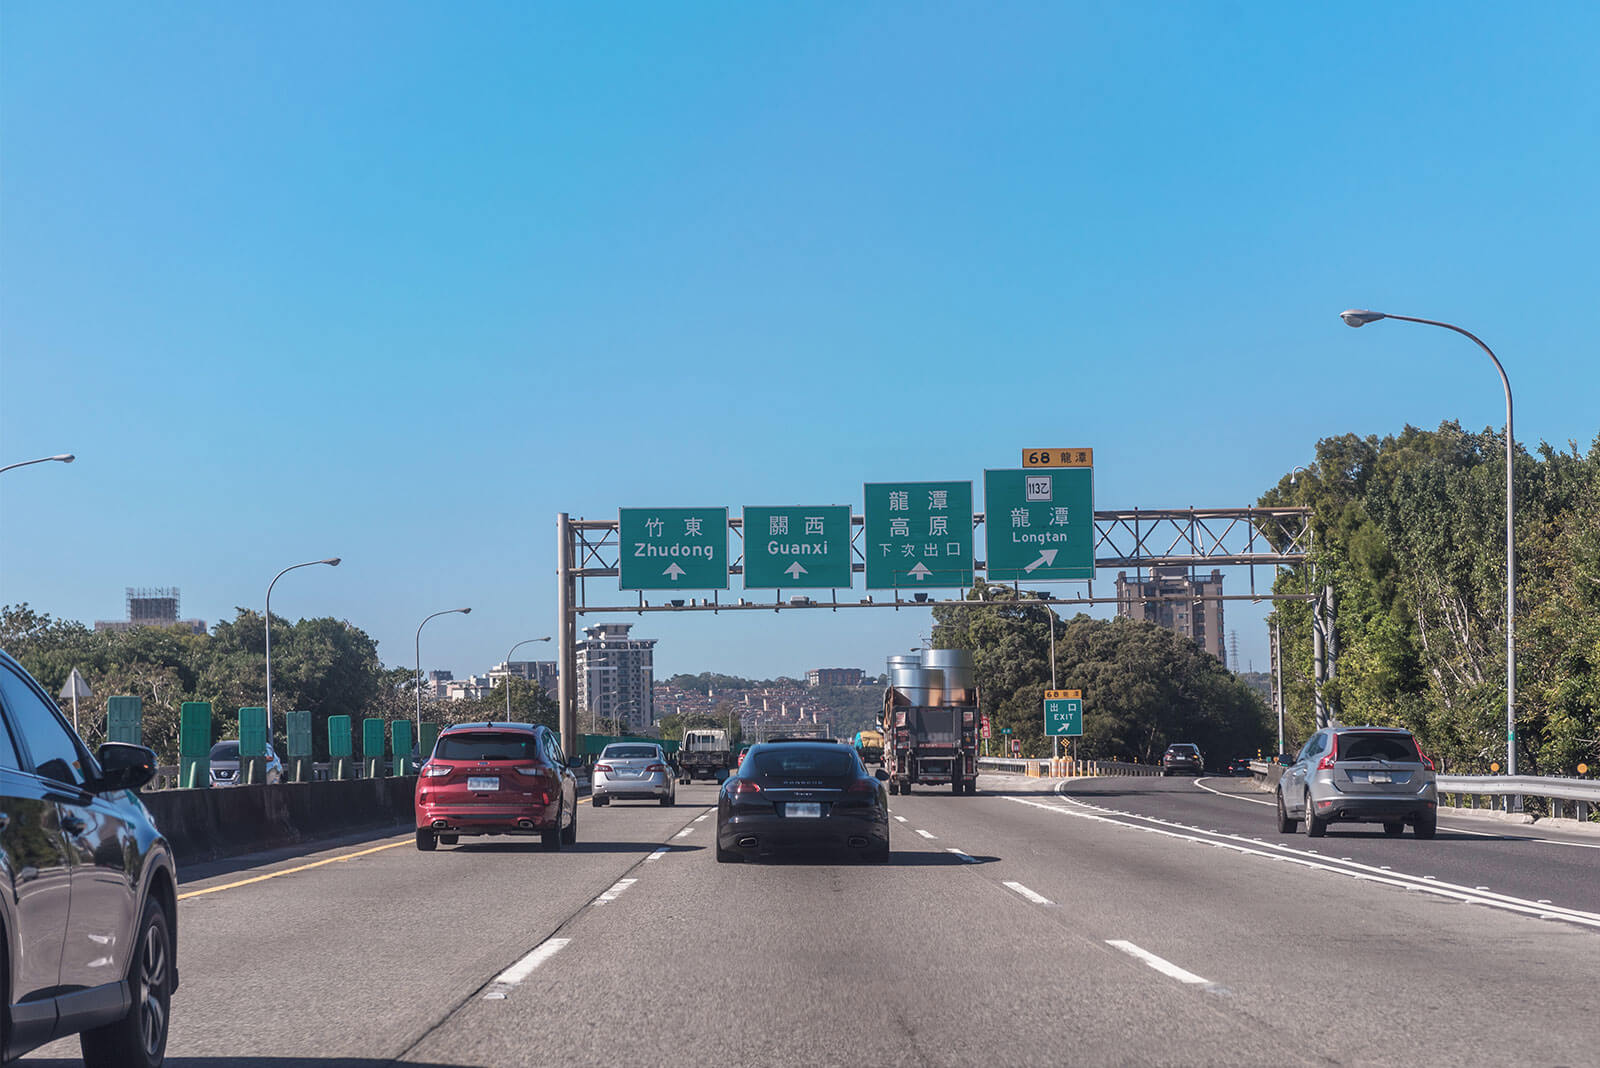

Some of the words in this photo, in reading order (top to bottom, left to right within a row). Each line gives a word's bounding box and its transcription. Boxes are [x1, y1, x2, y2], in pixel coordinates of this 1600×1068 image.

[1029, 452, 1050, 464] 68
[1028, 482, 1049, 495] 113乙
[888, 490, 948, 511] 龍潭
[769, 515, 825, 536] 關西
[1010, 507, 1069, 528] 龍潭
[644, 517, 703, 537] 竹東
[889, 516, 948, 537] 高原
[1012, 531, 1068, 545] Longtan
[633, 542, 713, 561] Zhudong
[767, 540, 828, 555] Guanxi
[878, 542, 961, 558] 下次出口
[1050, 703, 1076, 712] 出口
